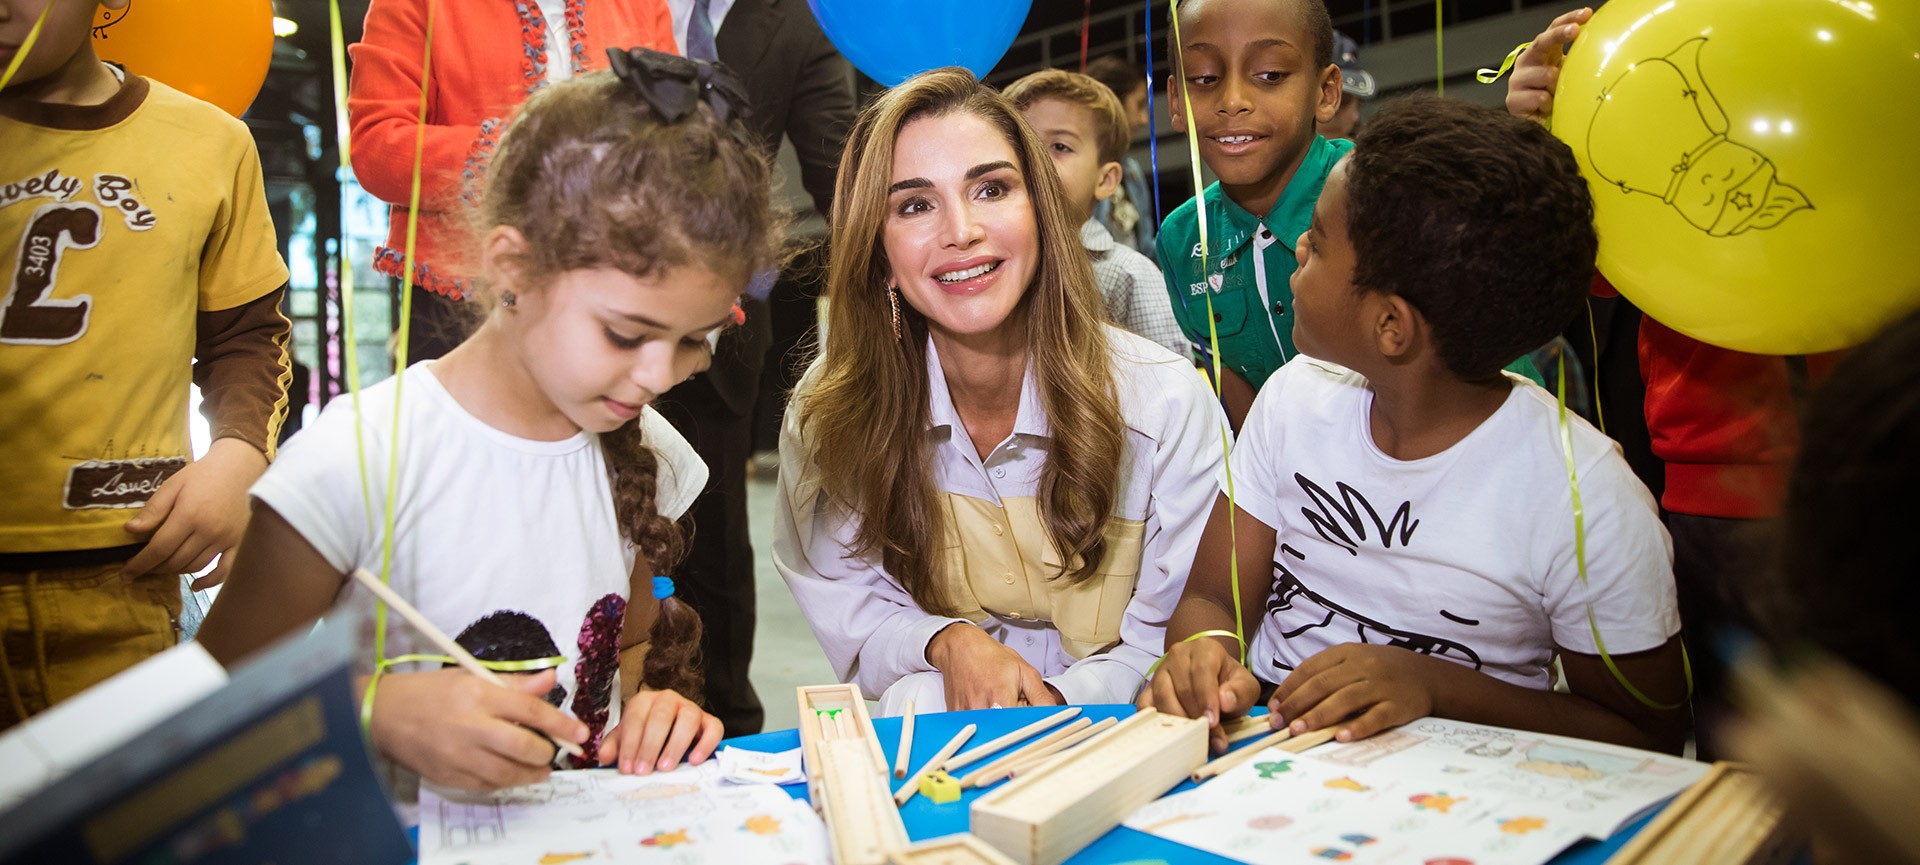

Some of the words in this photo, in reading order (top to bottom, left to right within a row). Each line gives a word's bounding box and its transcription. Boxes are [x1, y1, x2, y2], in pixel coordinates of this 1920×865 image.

[0, 168, 79, 204] vely
[97, 175, 156, 227] Boy
[0, 206, 100, 339] L
[25, 236, 52, 277] 3403
[91, 471, 162, 498] Lovel
